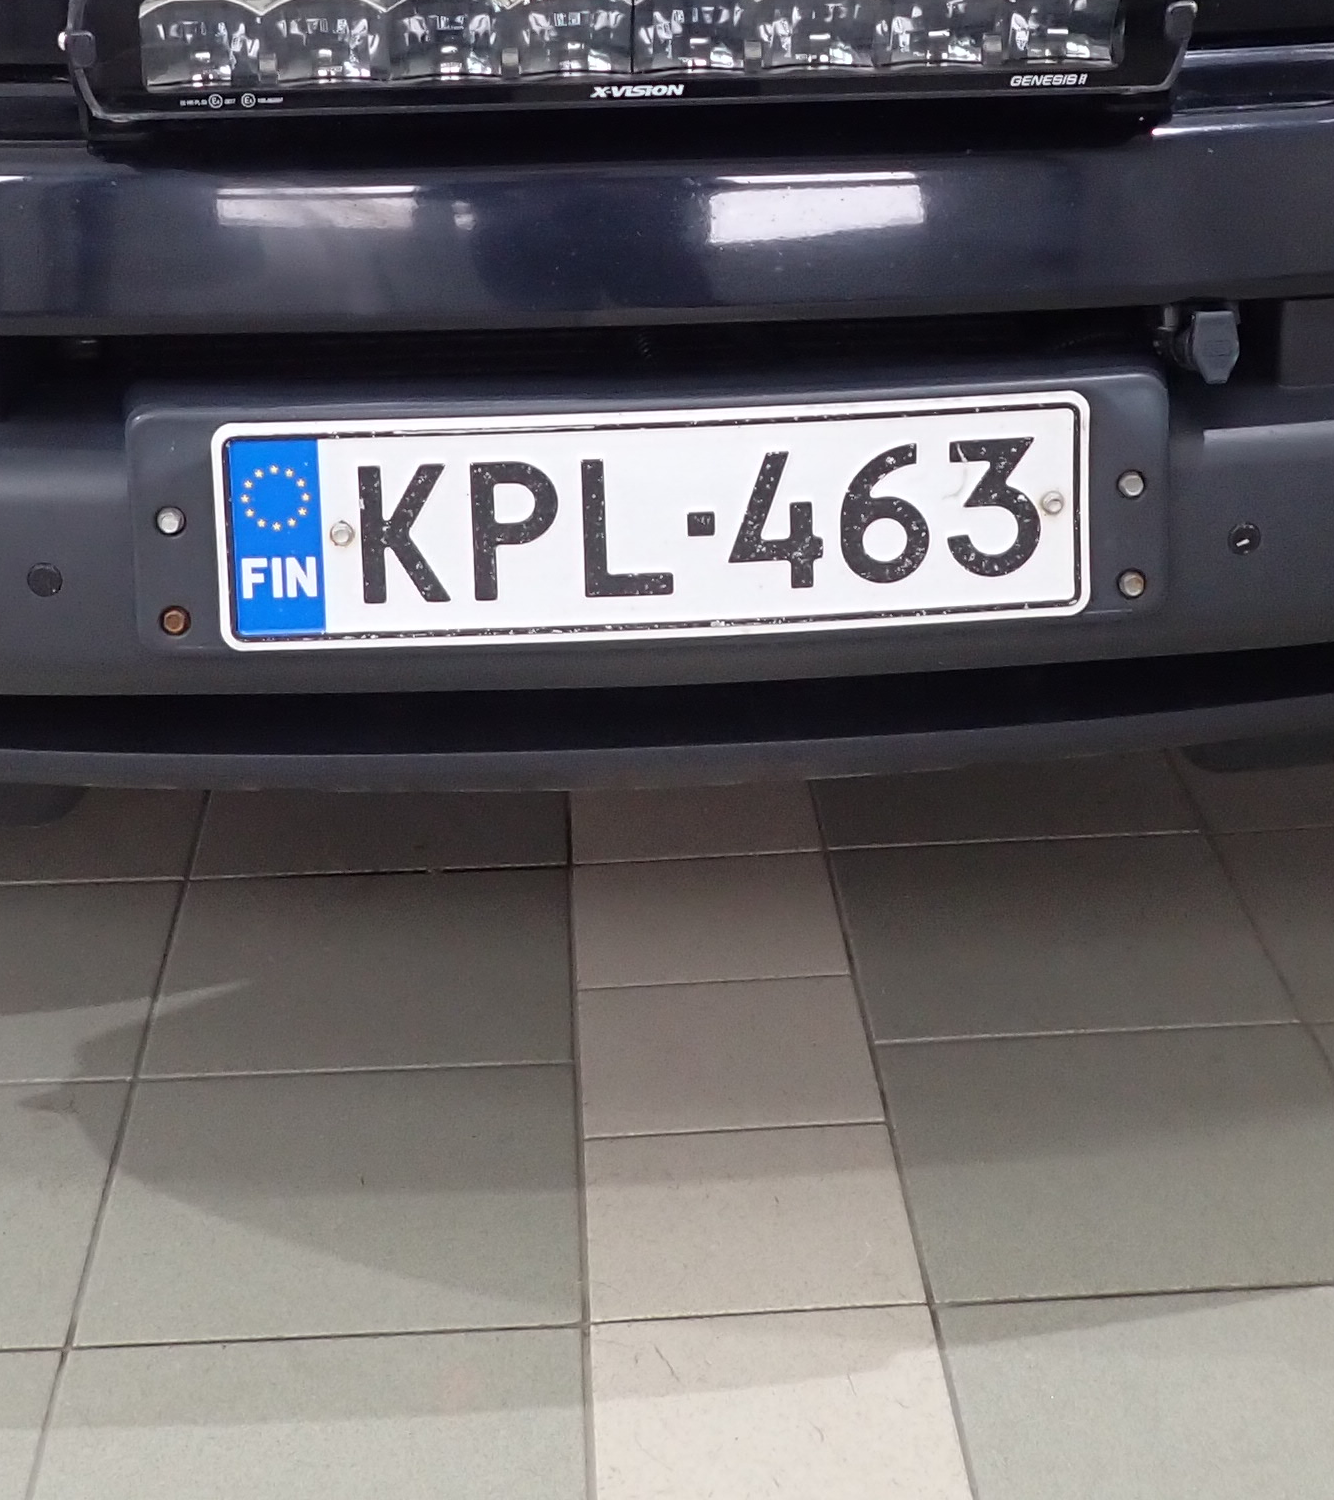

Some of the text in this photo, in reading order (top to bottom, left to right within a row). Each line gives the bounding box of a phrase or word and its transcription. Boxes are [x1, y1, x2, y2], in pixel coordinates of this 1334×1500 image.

[589, 84, 685, 98] X-VISION
[1010, 73, 1078, 87] GENESIS
[358, 436, 1042, 605] KPL-463
[241, 554, 318, 600] FIN
